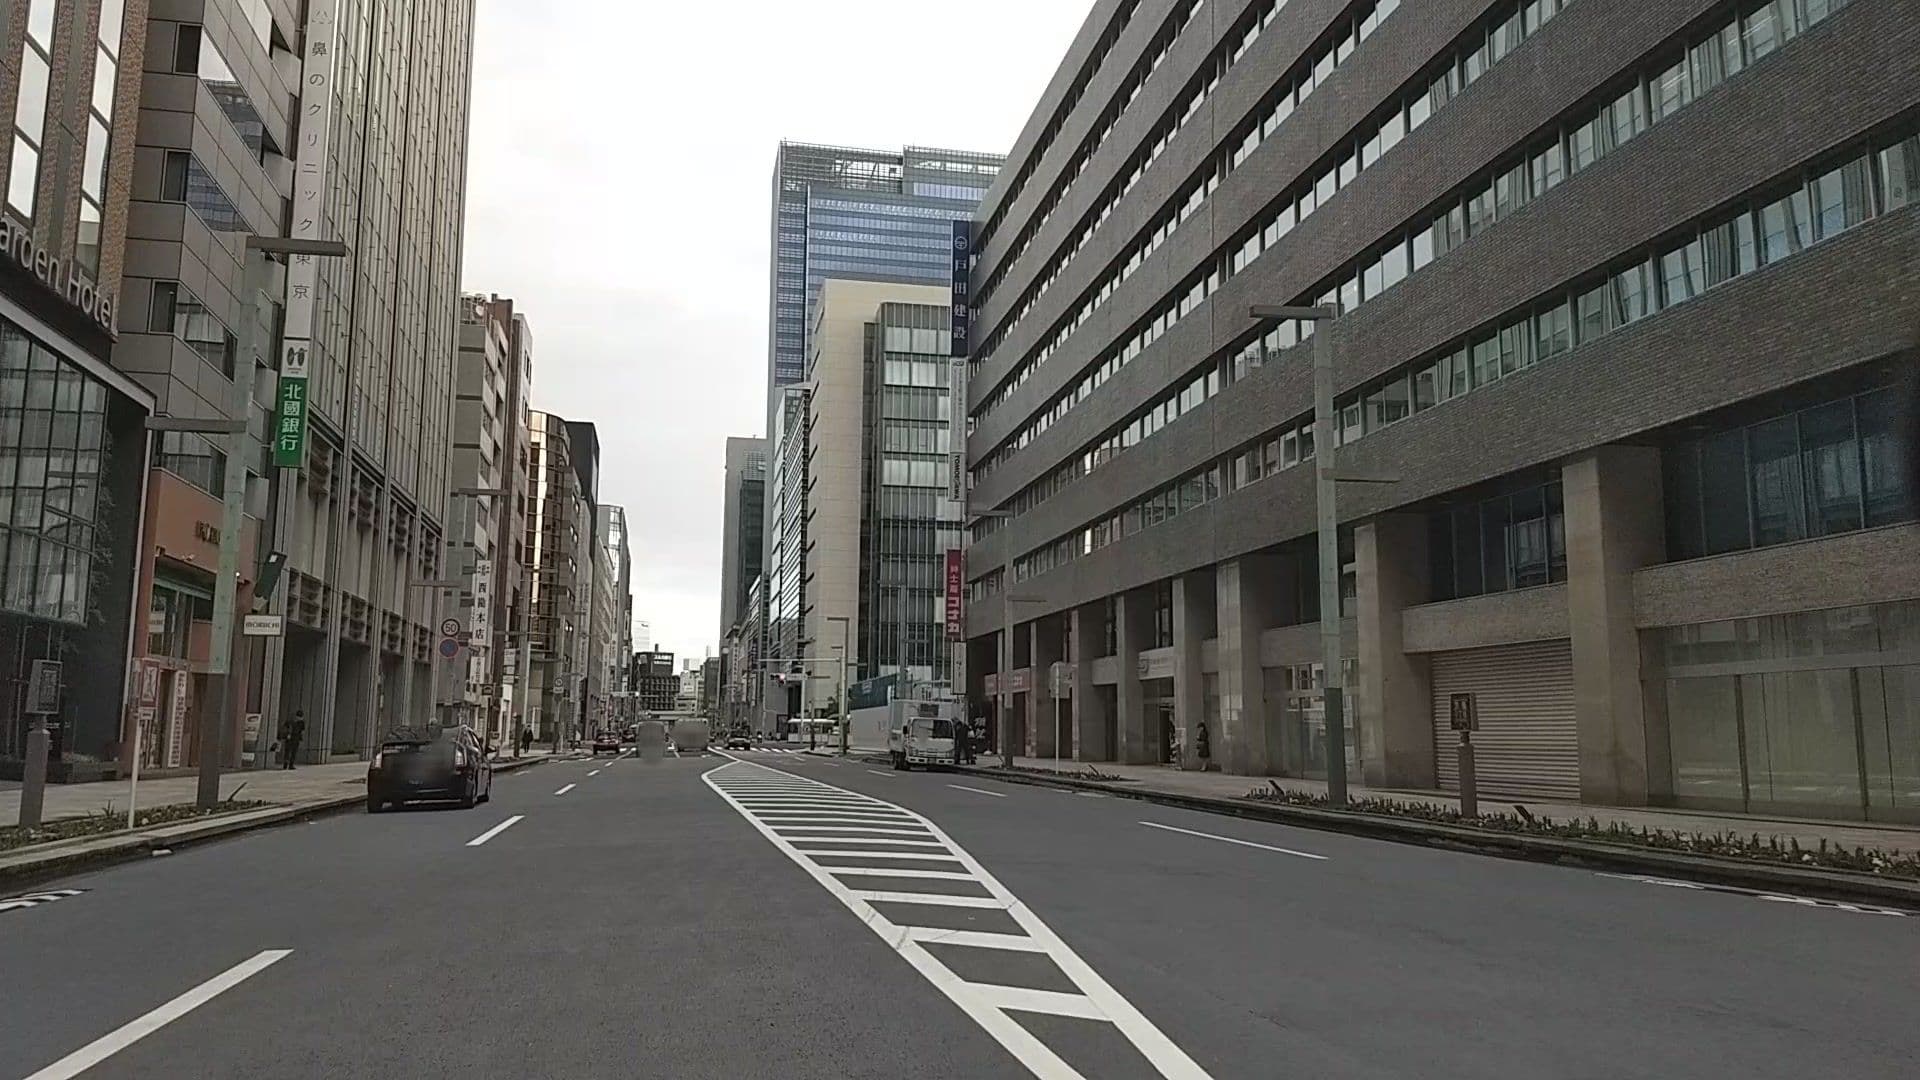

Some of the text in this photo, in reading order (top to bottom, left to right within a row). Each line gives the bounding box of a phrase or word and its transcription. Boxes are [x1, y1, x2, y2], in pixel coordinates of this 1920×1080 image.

[66, 258, 119, 337] Hotel
[953, 258, 967, 340] 戸田建設
[280, 383, 302, 451] 北國銀行
[444, 622, 457, 633] 50
